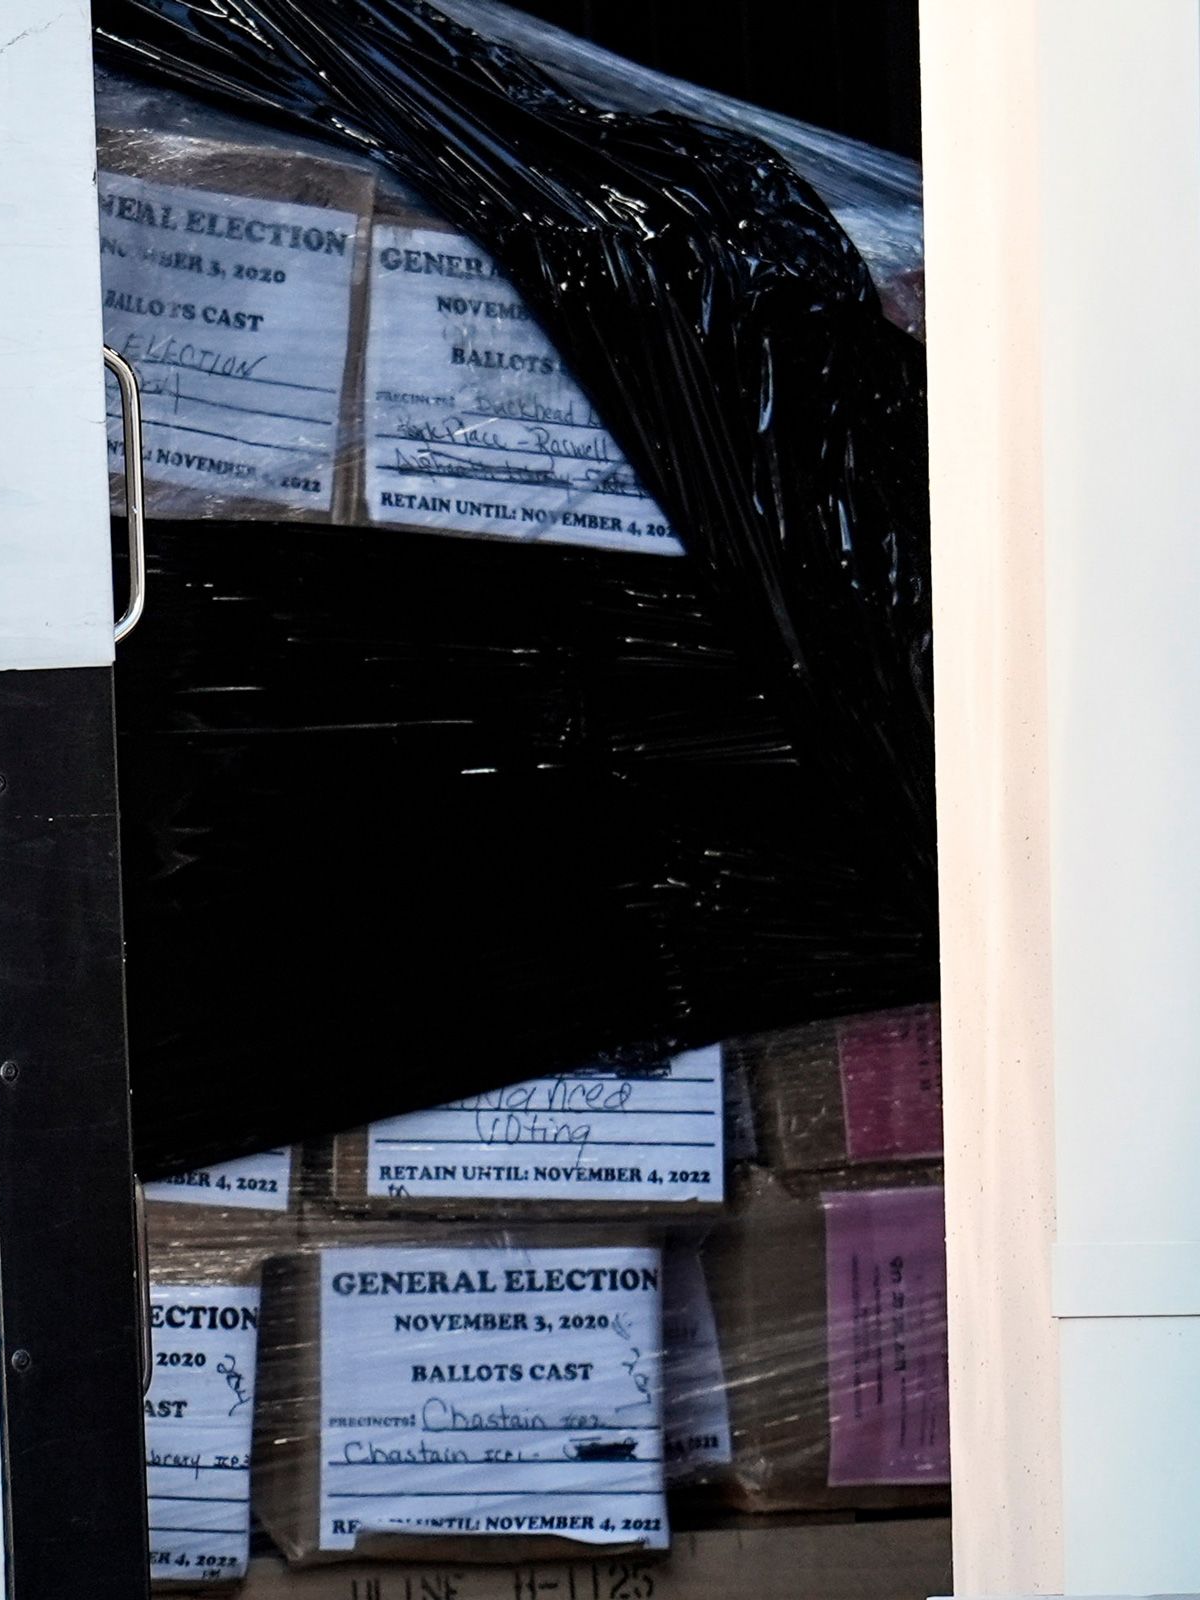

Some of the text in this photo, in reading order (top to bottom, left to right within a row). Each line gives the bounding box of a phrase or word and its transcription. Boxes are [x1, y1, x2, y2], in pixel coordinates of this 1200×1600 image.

[184, 208, 347, 255] ELECTION
[232, 264, 286, 283] 2020
[202, 306, 264, 332] CAST
[451, 346, 554, 375] BALLOTS
[380, 491, 678, 539] RETAIN UNTIL: NOVEMBER 4, 202
[215, 1174, 232, 1191] 4,
[236, 1177, 278, 1193] 2022
[379, 1166, 711, 1185] RETAIN UNTIL: NOVEMBER 4, 2022
[331, 1268, 660, 1297] GENERAL ELECTION
[393, 1313, 609, 1333] NOVEMBER 3, 2020
[155, 1352, 207, 1367] 2020
[411, 1363, 595, 1384] BALLOTS CAST
[328, 1414, 417, 1428] PRECINCTS:
[421, 1397, 548, 1430] Chastain
[343, 1440, 470, 1464] Chastain
[485, 1516, 595, 1531] NOVEMBER
[600, 1517, 616, 1532] 4,
[621, 1517, 661, 1532] 2022
[195, 1553, 238, 1567] 2022
